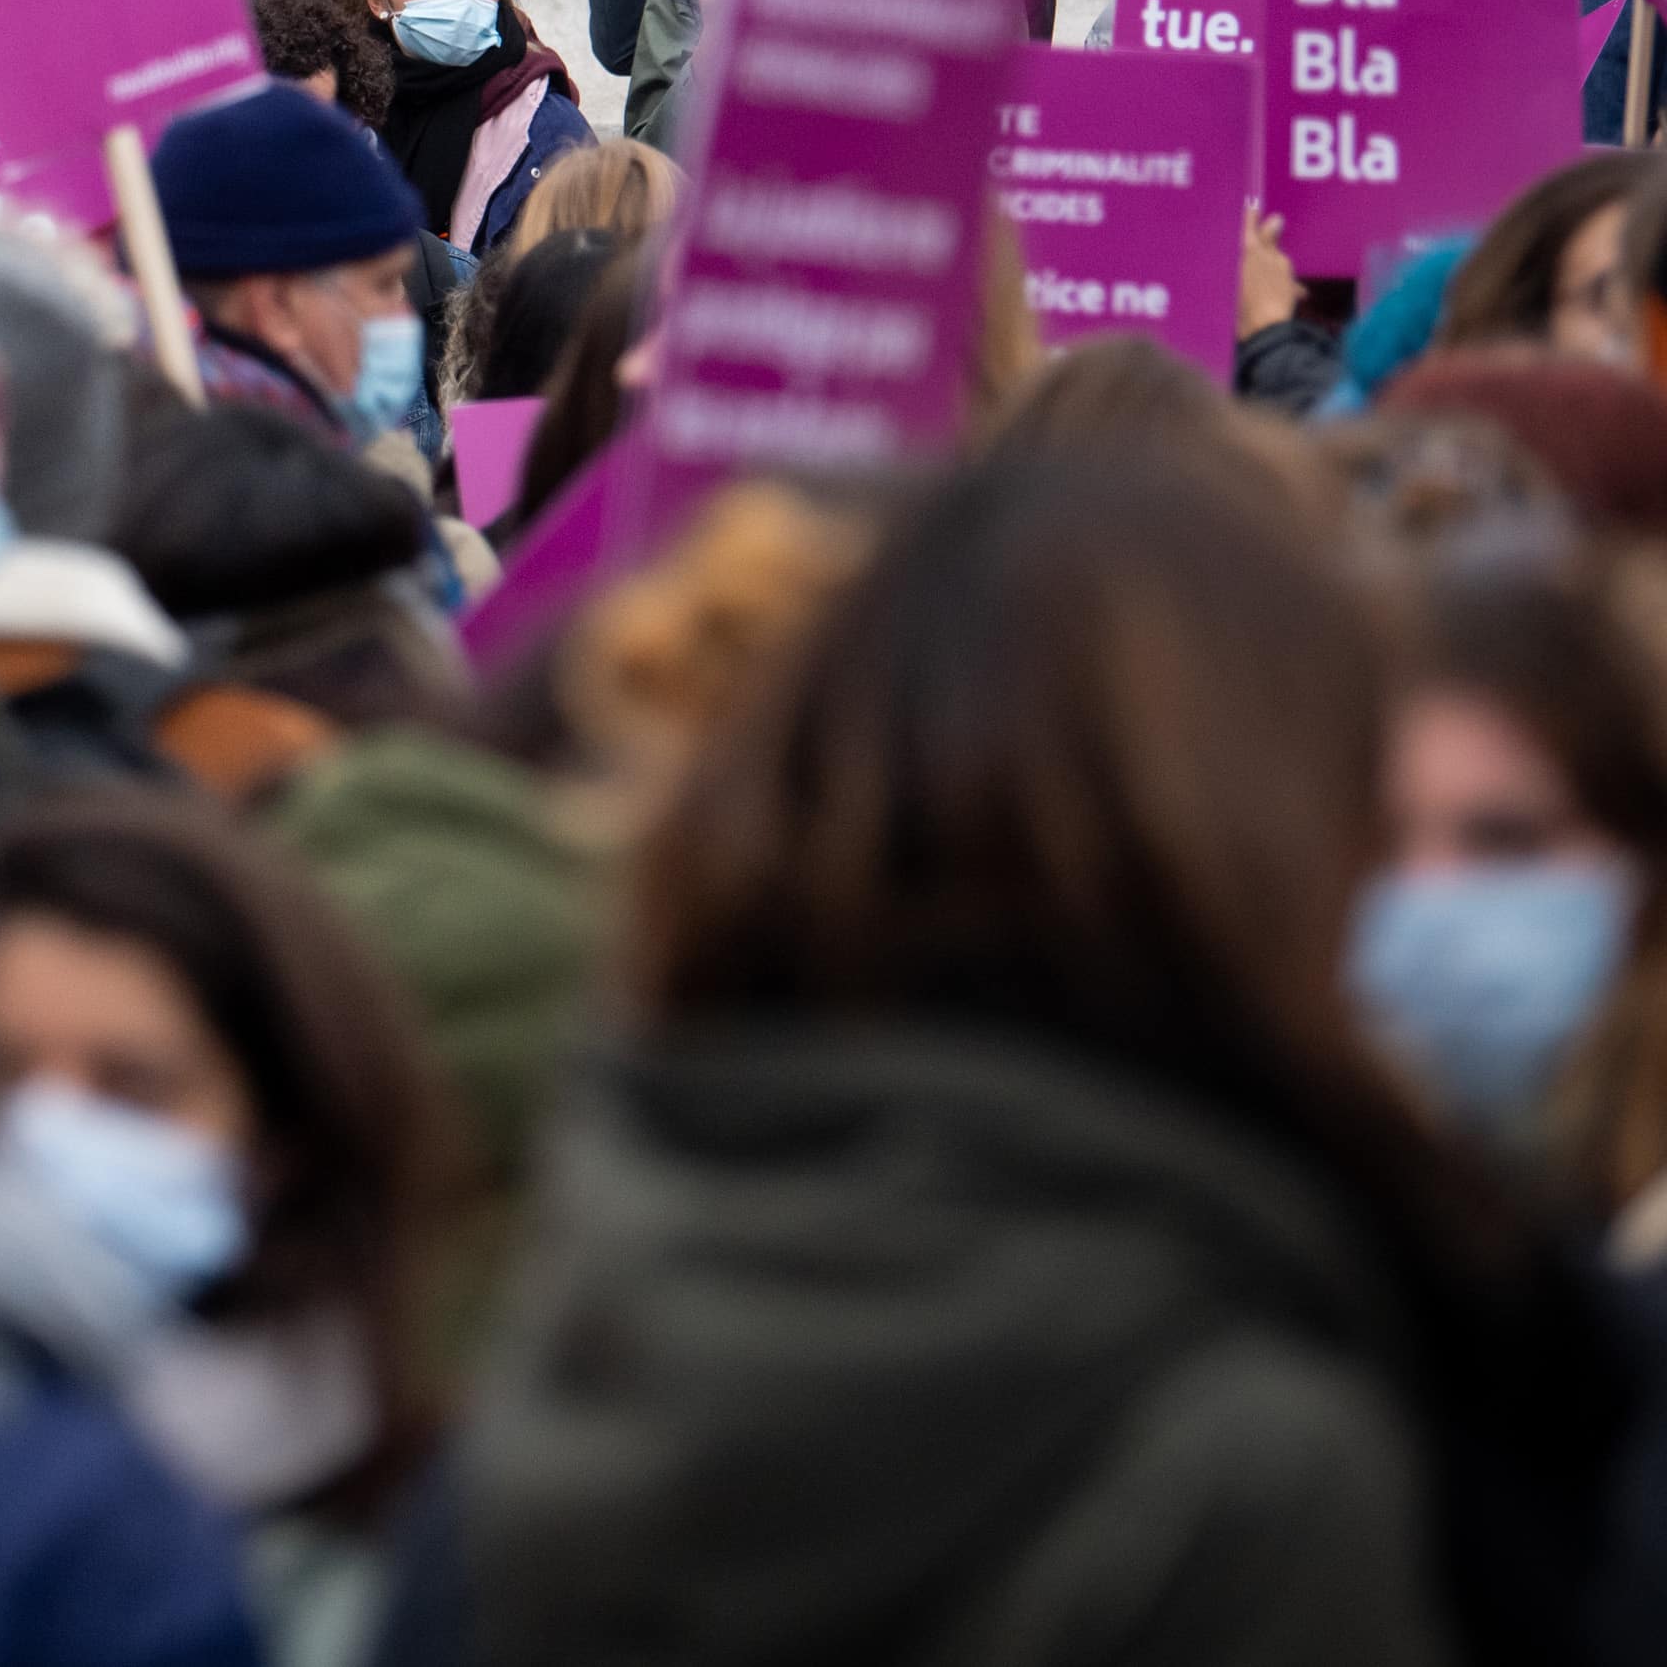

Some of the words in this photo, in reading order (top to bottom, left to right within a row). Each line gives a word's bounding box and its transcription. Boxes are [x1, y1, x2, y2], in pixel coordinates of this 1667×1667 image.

[1292, 28, 1399, 96] Bla
[1290, 114, 1398, 183] Bla
[1113, 282, 1168, 317] ne
